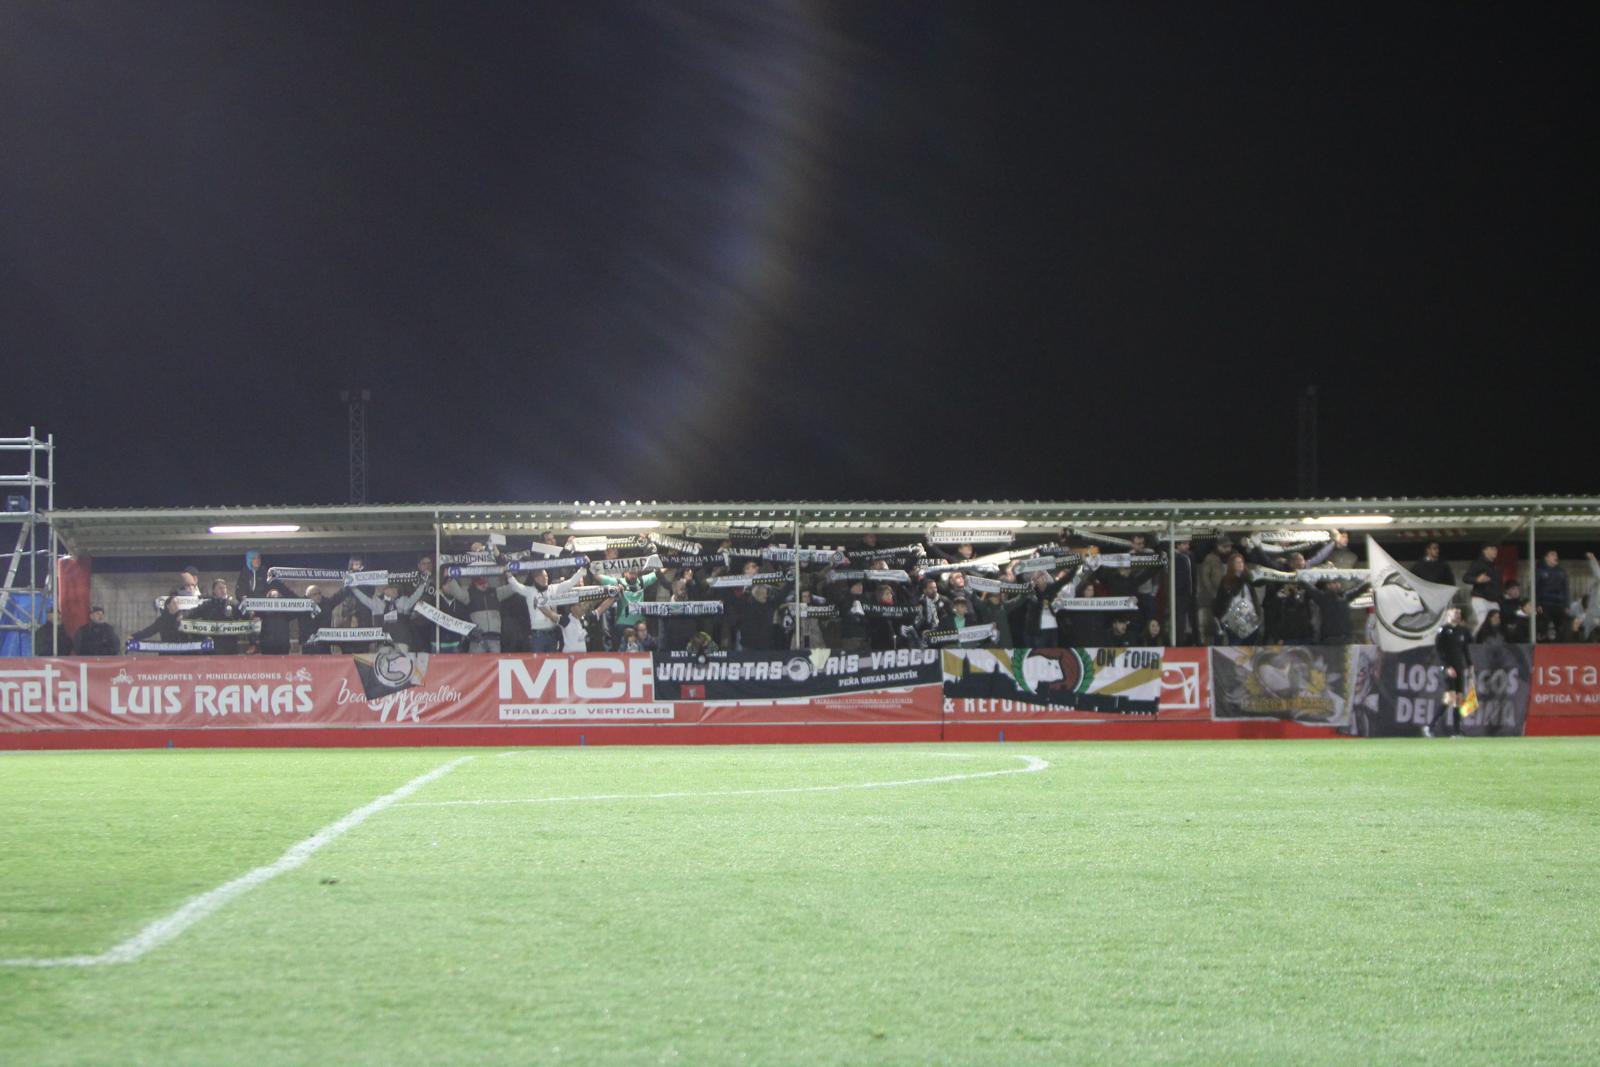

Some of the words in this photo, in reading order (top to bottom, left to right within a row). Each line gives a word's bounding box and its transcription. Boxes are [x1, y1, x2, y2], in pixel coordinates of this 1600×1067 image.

[602, 556, 647, 570] EXILIAD
[1096, 648, 1116, 667] ON
[137, 673, 193, 681] TRANSPORTES
[206, 672, 282, 681] MINIEXCAVACIONES
[656, 661, 783, 681] UNIONISTAS
[861, 673, 886, 684] OSKAR
[1397, 663, 1440, 692] LOS
[110, 685, 183, 715] LUIS
[194, 684, 314, 717] RAMAS
[503, 707, 577, 716] TRABAJOS
[586, 706, 671, 716] VERTICALES
